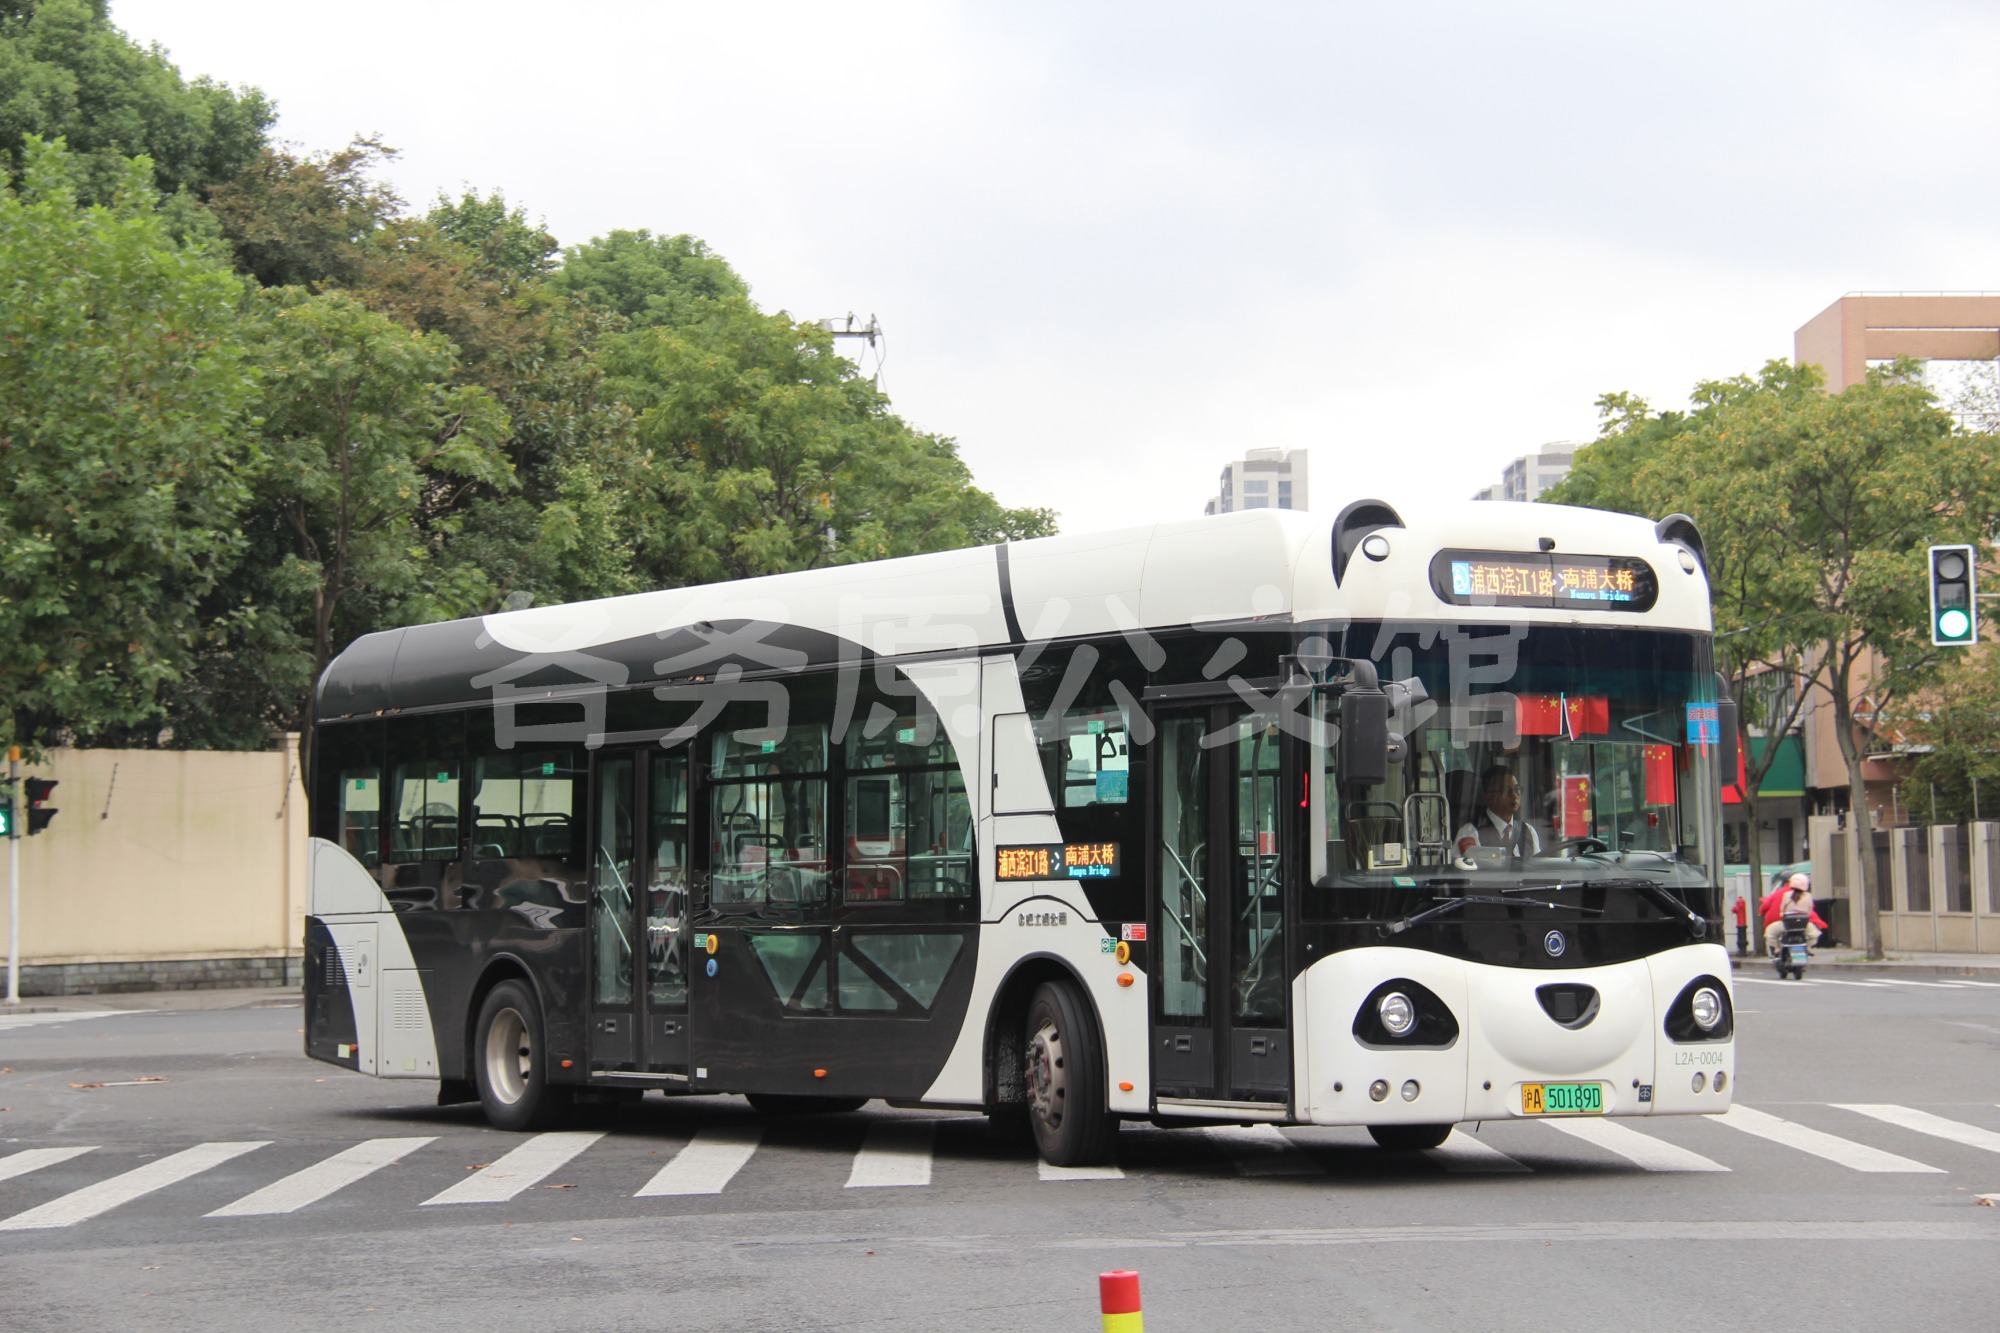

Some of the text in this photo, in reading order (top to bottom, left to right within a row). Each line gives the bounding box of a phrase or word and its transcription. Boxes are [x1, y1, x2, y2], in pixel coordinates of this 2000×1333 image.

[1469, 565, 1635, 598] 浦西滨江1路 南浦大桥
[1599, 590, 1630, 602] Bridge
[998, 843, 1114, 878] 浦西滨江1路 南浦大桥
[1069, 865, 1111, 878] Nanpu Bridge
[1675, 1052, 1723, 1066] L2A-0004
